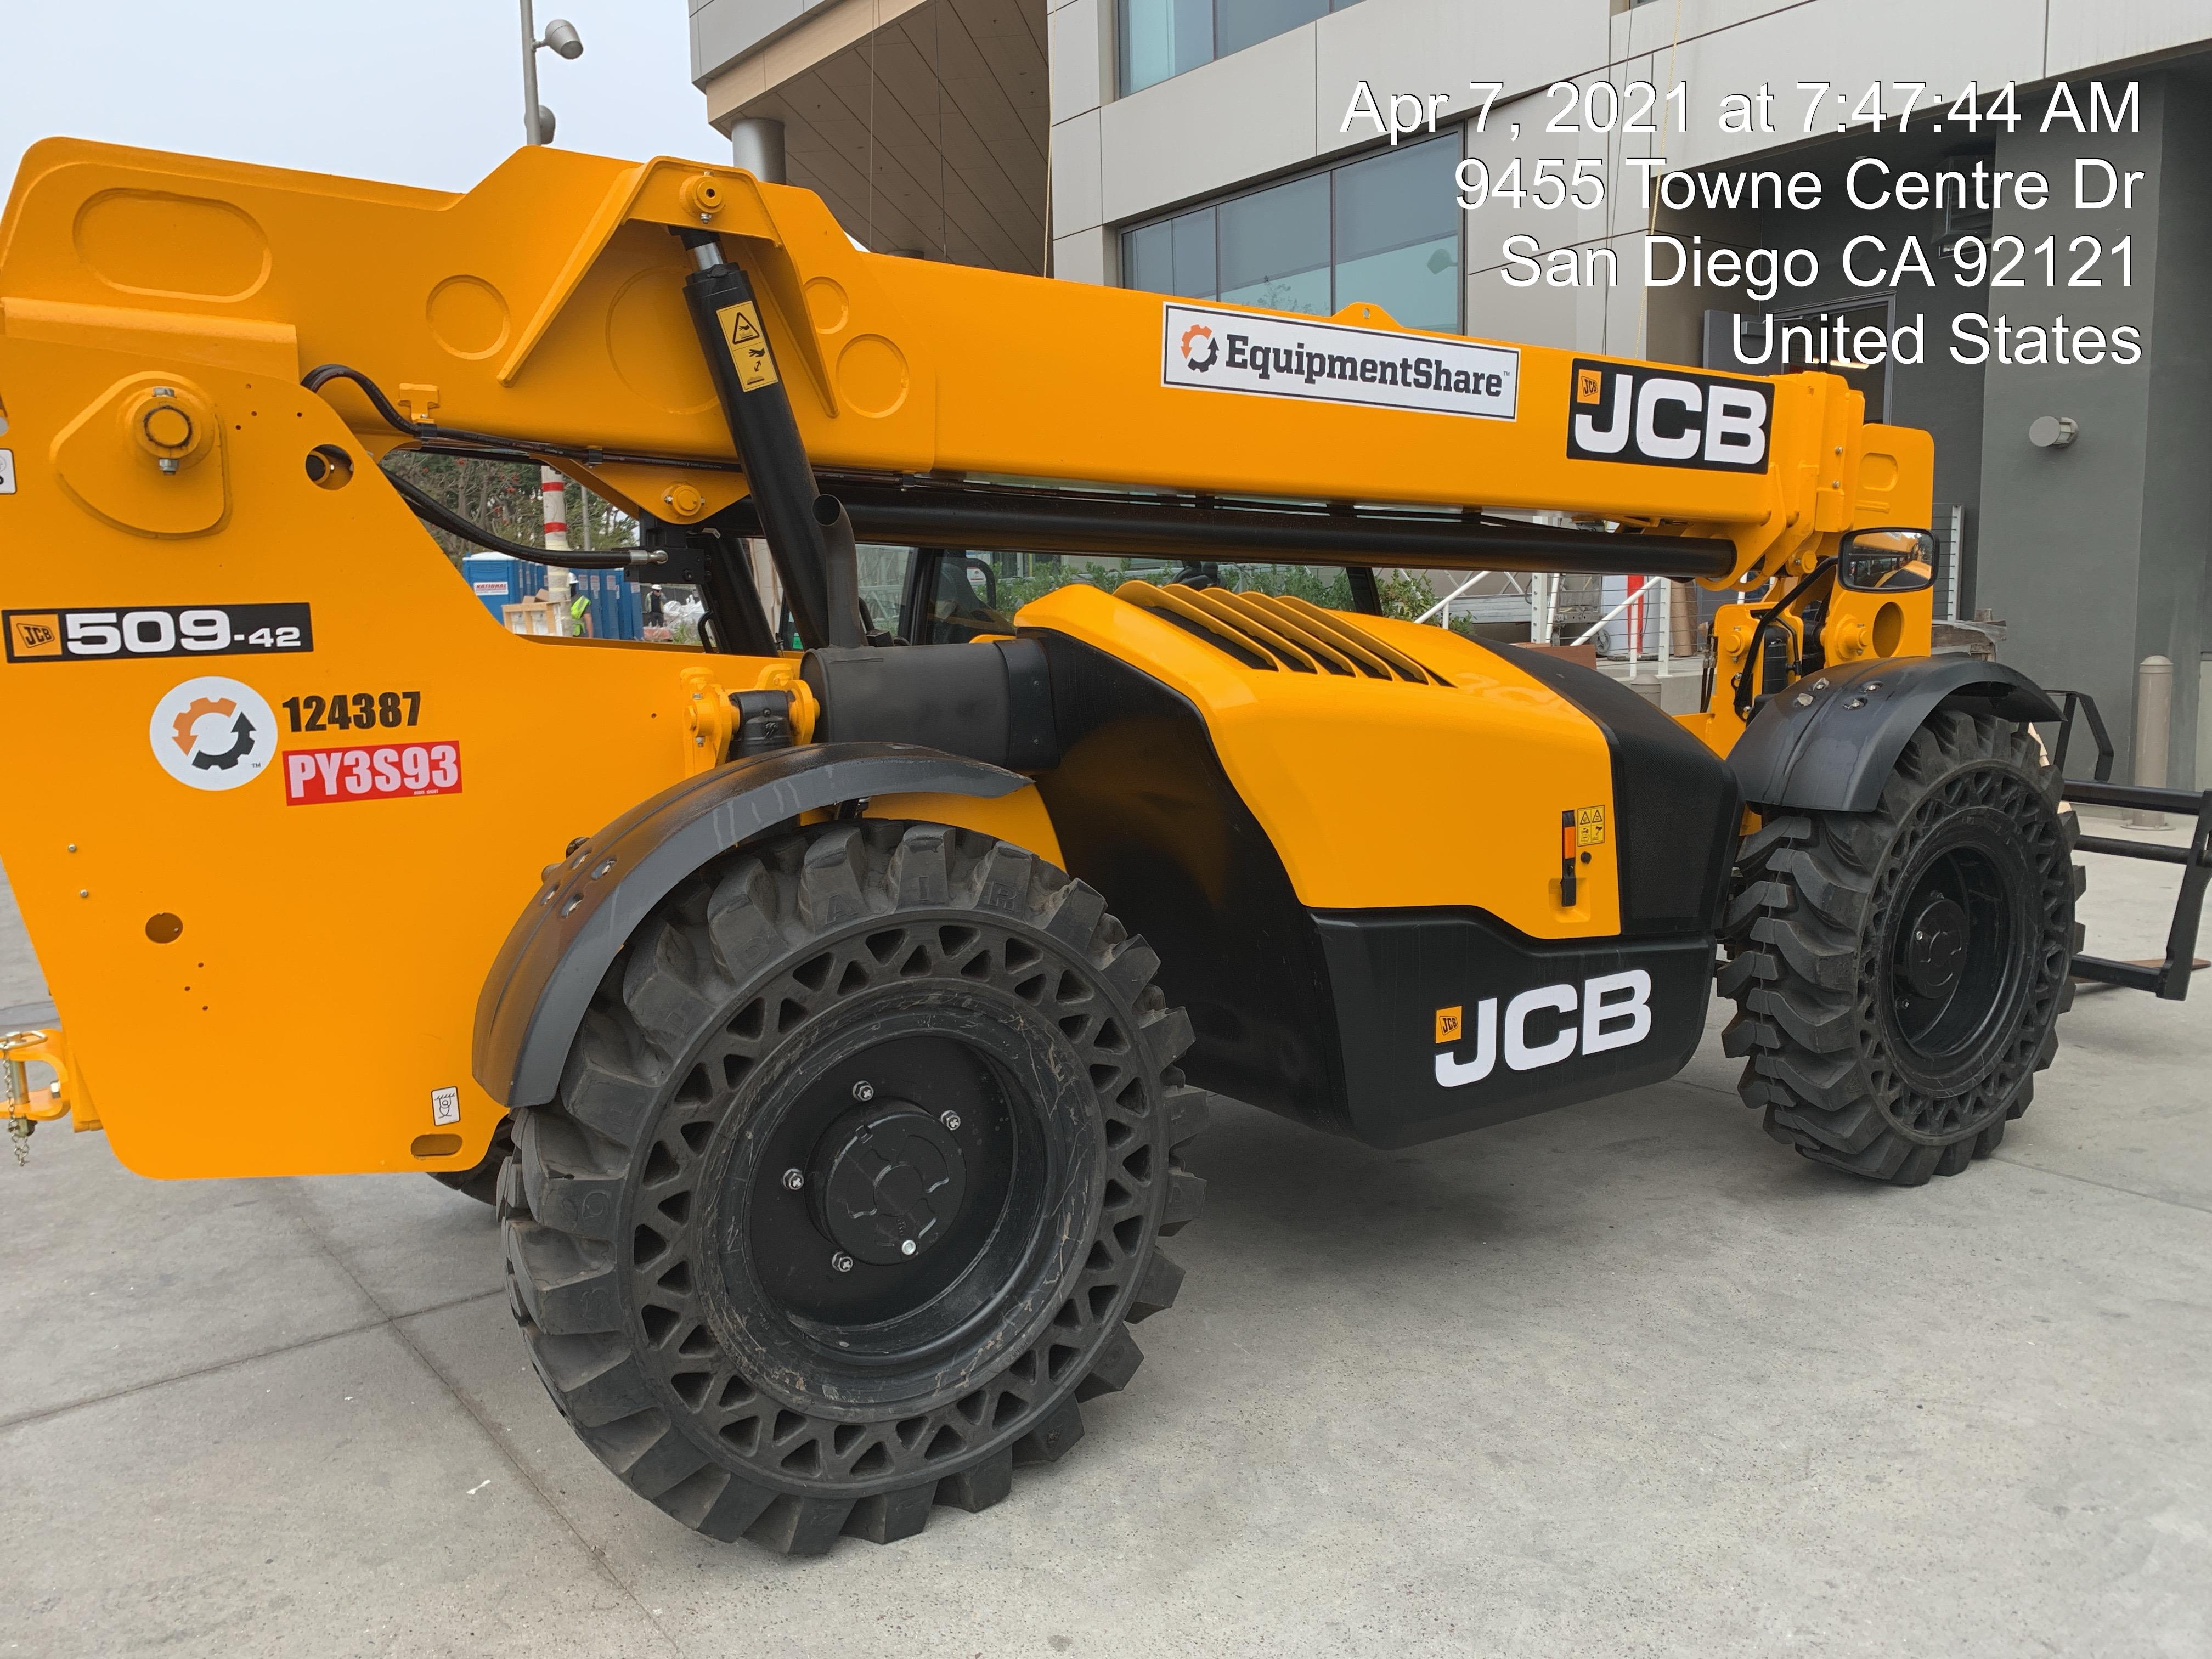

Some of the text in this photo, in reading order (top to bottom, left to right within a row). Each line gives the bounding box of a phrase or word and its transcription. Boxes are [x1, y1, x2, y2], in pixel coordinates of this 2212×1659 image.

[1226, 334, 1503, 397] EquipmentShare
[1584, 378, 1597, 394] JCB
[1575, 373, 1767, 464] JCB
[23, 626, 52, 645] JCB
[65, 610, 301, 654] 509-42
[282, 691, 421, 732] 124387
[288, 746, 458, 797] PY3S93
[1435, 969, 1651, 1087] JCB
[1442, 1018, 1457, 1034] JCB
